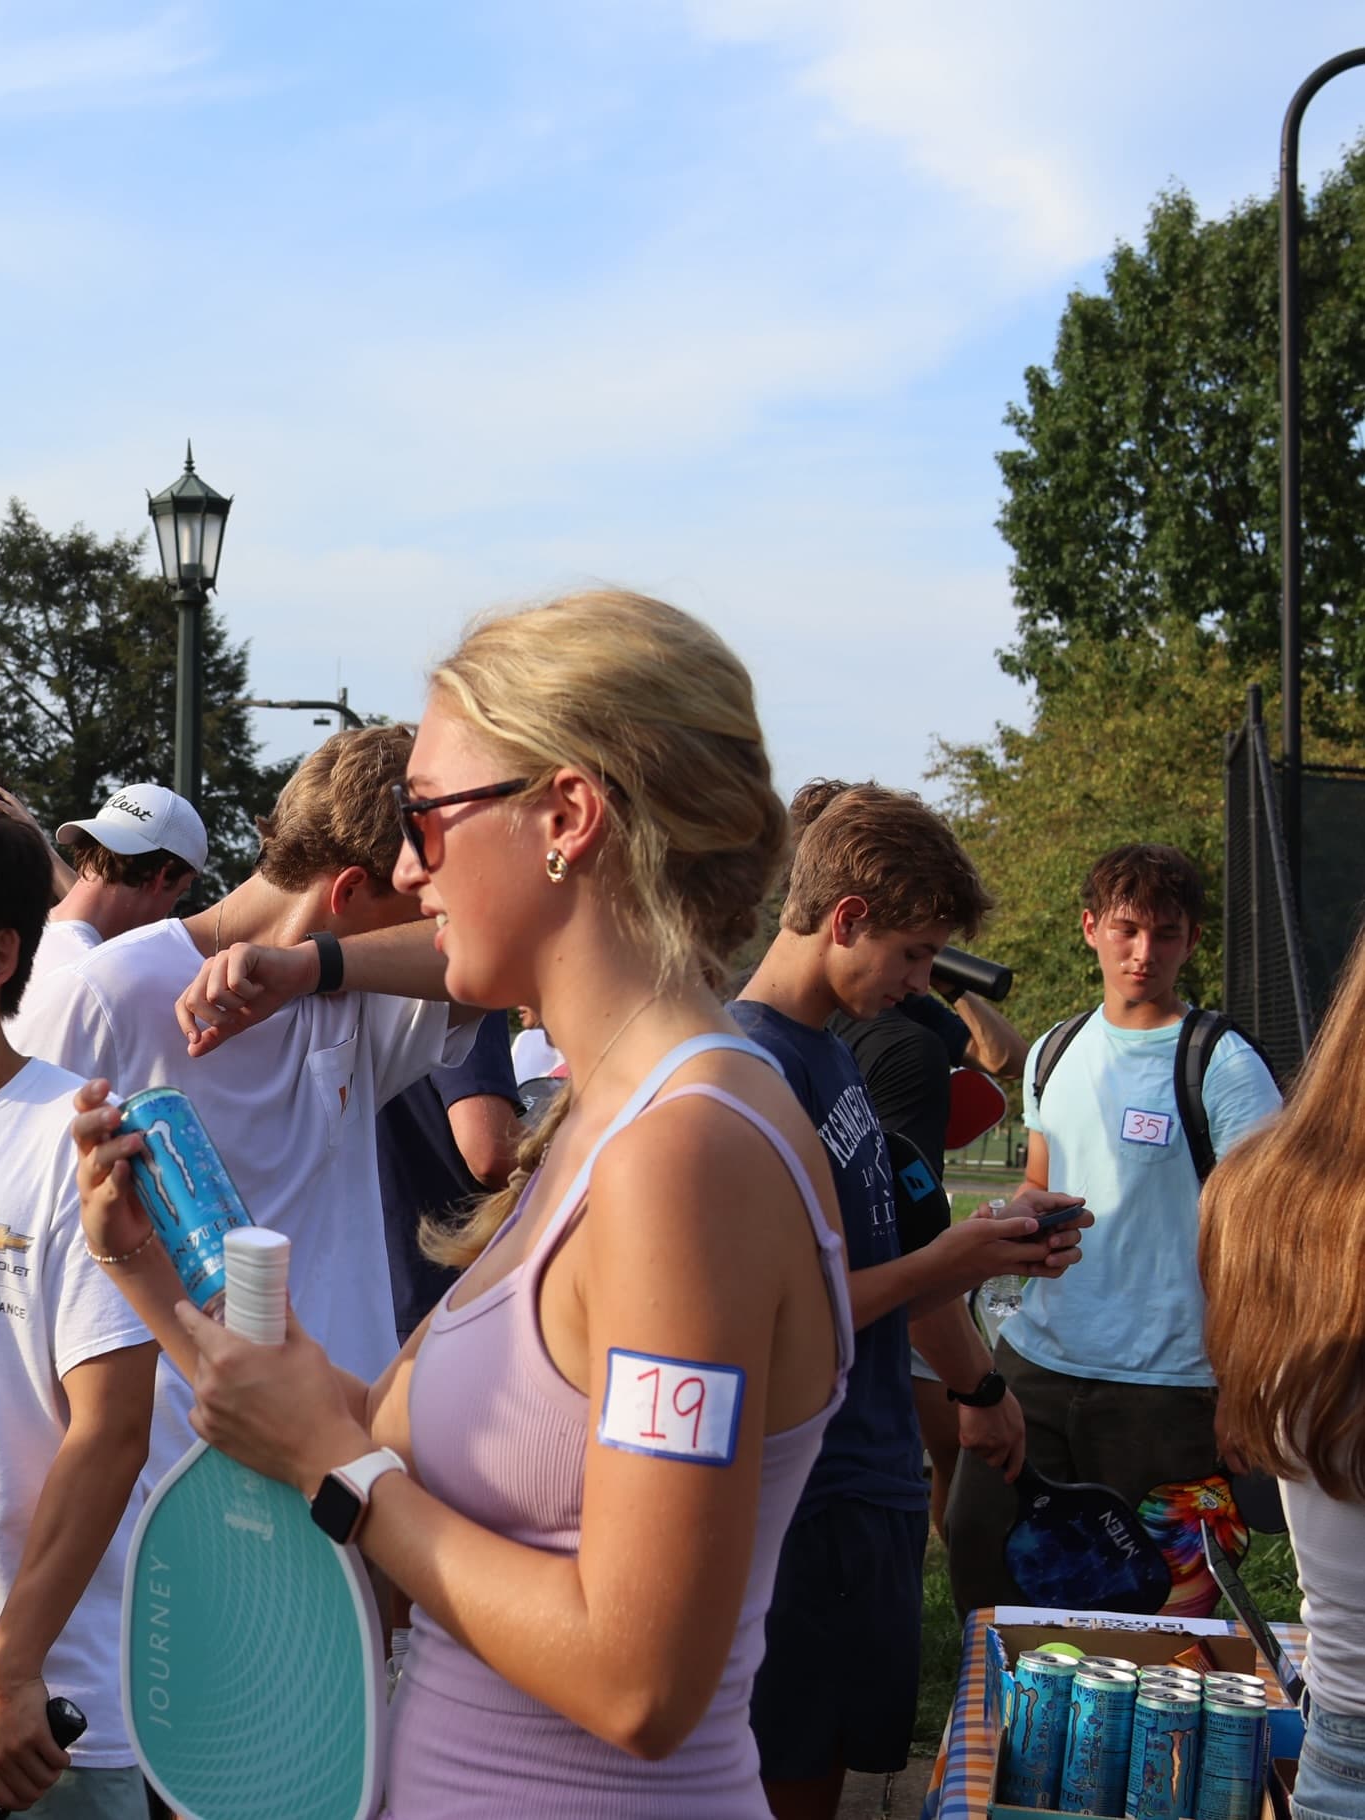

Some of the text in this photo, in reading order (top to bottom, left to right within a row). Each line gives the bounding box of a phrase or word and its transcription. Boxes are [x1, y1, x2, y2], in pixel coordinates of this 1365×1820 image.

[1128, 1114, 1163, 1140] 35
[637, 1367, 706, 1449] 19
[1098, 1510, 1137, 1560] MTEN
[148, 1554, 172, 1729] JOURNEY
